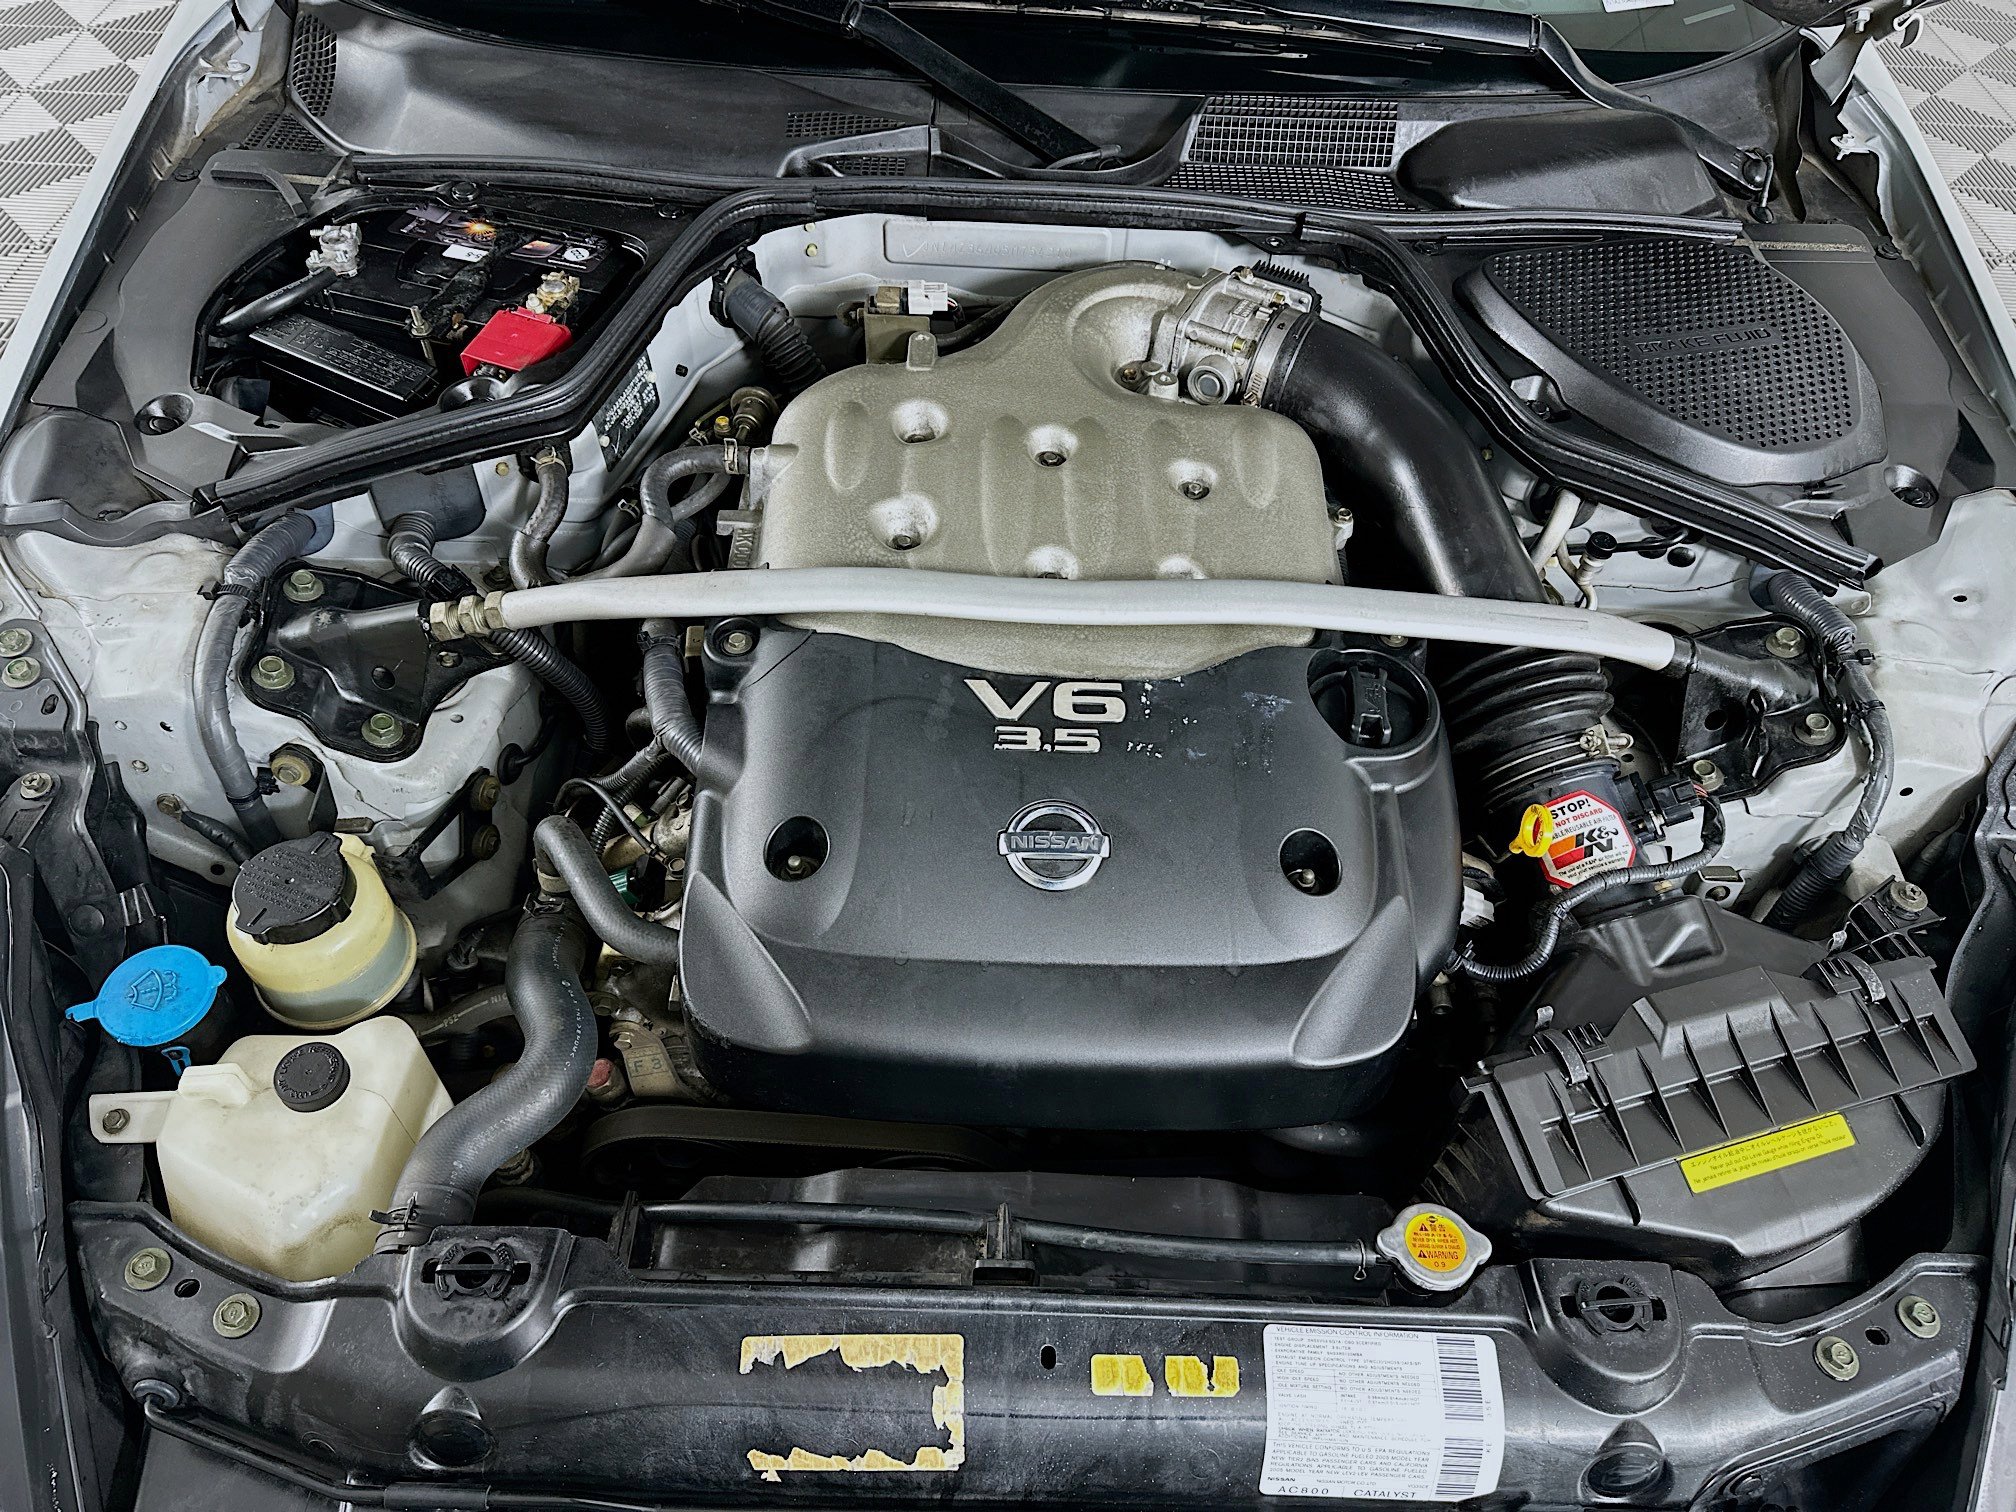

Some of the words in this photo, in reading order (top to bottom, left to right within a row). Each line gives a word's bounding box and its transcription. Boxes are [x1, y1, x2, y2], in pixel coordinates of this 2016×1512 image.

[1635, 336, 1710, 352] BRAKE
[1712, 328, 1772, 344] FLUID
[964, 679, 1127, 723] V6
[993, 726, 1101, 753] 3.5
[1552, 798, 1591, 820] STOP!
[1555, 818, 1571, 828] NOT
[1573, 808, 1603, 822] DISCARD
[1010, 834, 1100, 850] NISSAN
[443, 1013, 460, 1028] PS2
[1426, 1250, 1458, 1259] WARNING
[1278, 1486, 1328, 1495] AC800
[1354, 1489, 1416, 1498] CATALYST
